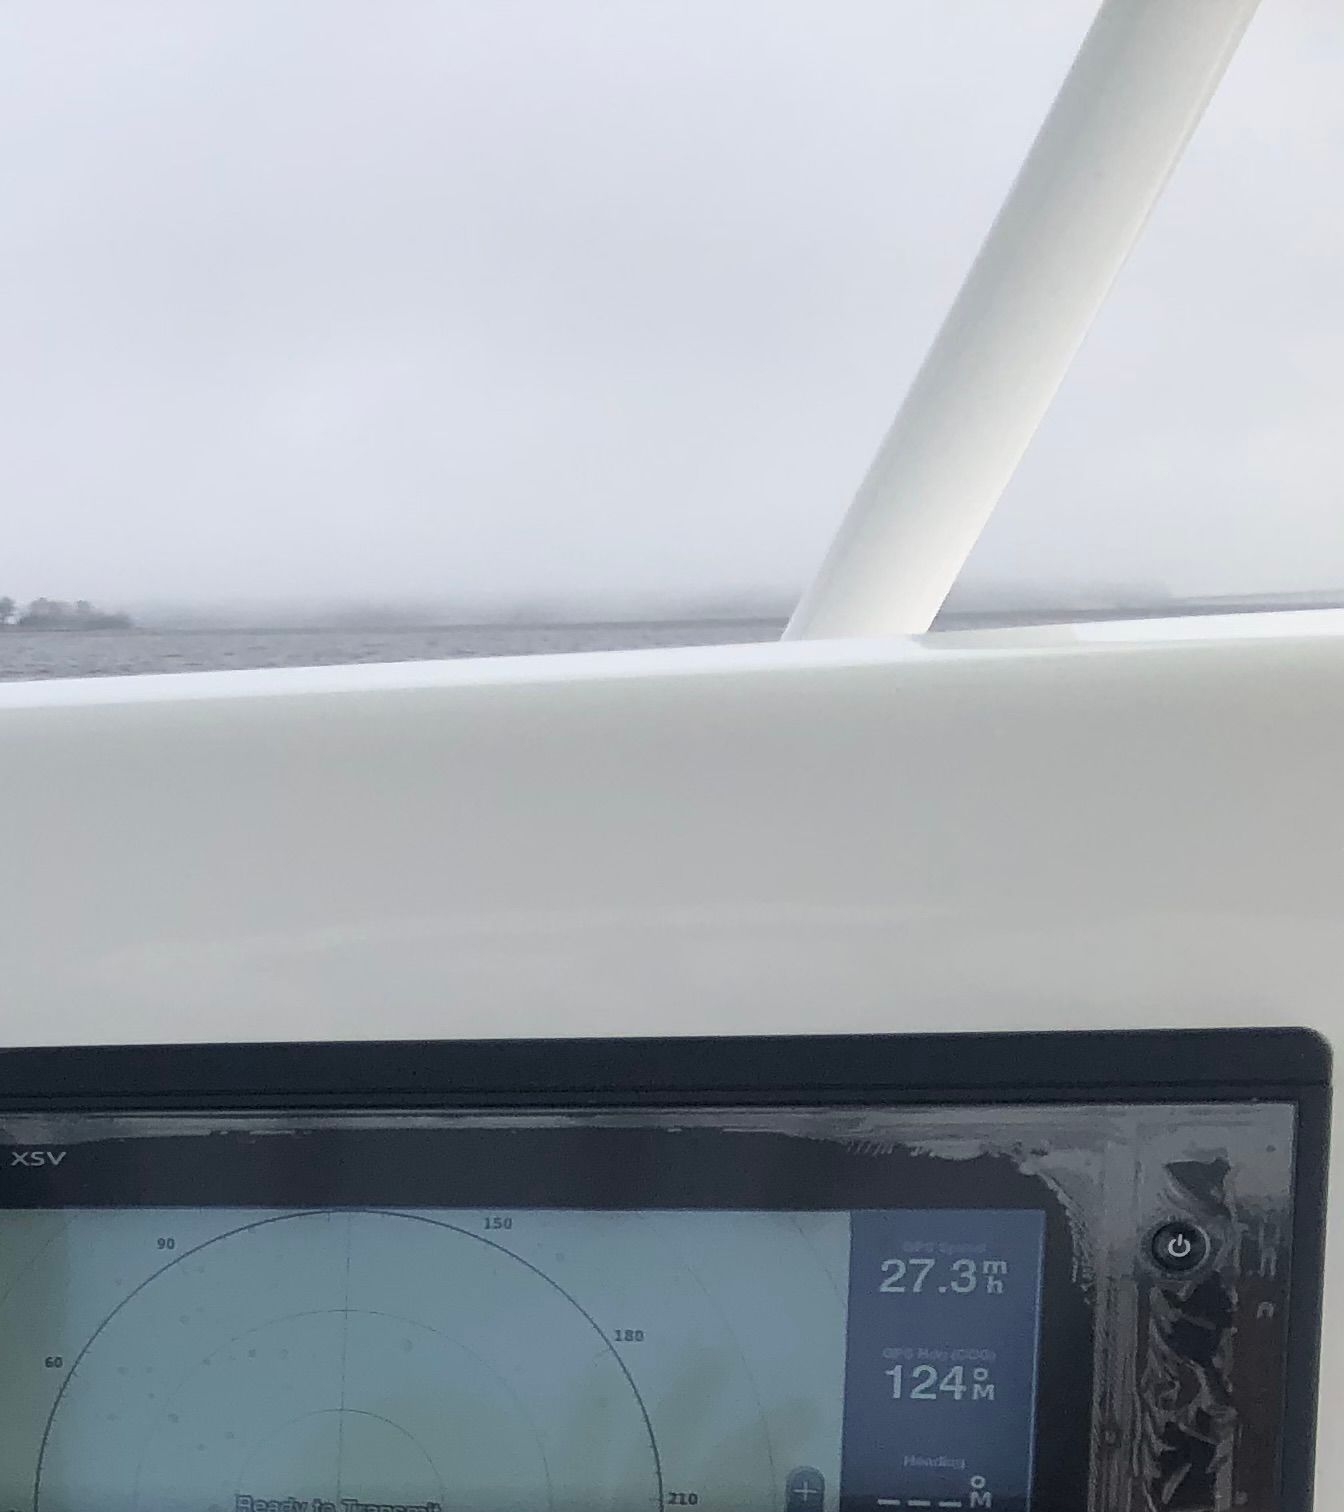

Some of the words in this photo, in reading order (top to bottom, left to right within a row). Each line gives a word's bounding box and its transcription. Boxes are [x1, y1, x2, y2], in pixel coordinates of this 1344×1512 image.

[11, 1151, 67, 1166] XSV
[483, 1217, 513, 1231] 150
[156, 1237, 175, 1251] 90
[879, 1258, 977, 1293] 27.3
[614, 1329, 644, 1342] 180
[45, 1357, 63, 1369] 60
[884, 1364, 967, 1400] 124
[668, 1492, 699, 1506] 210
